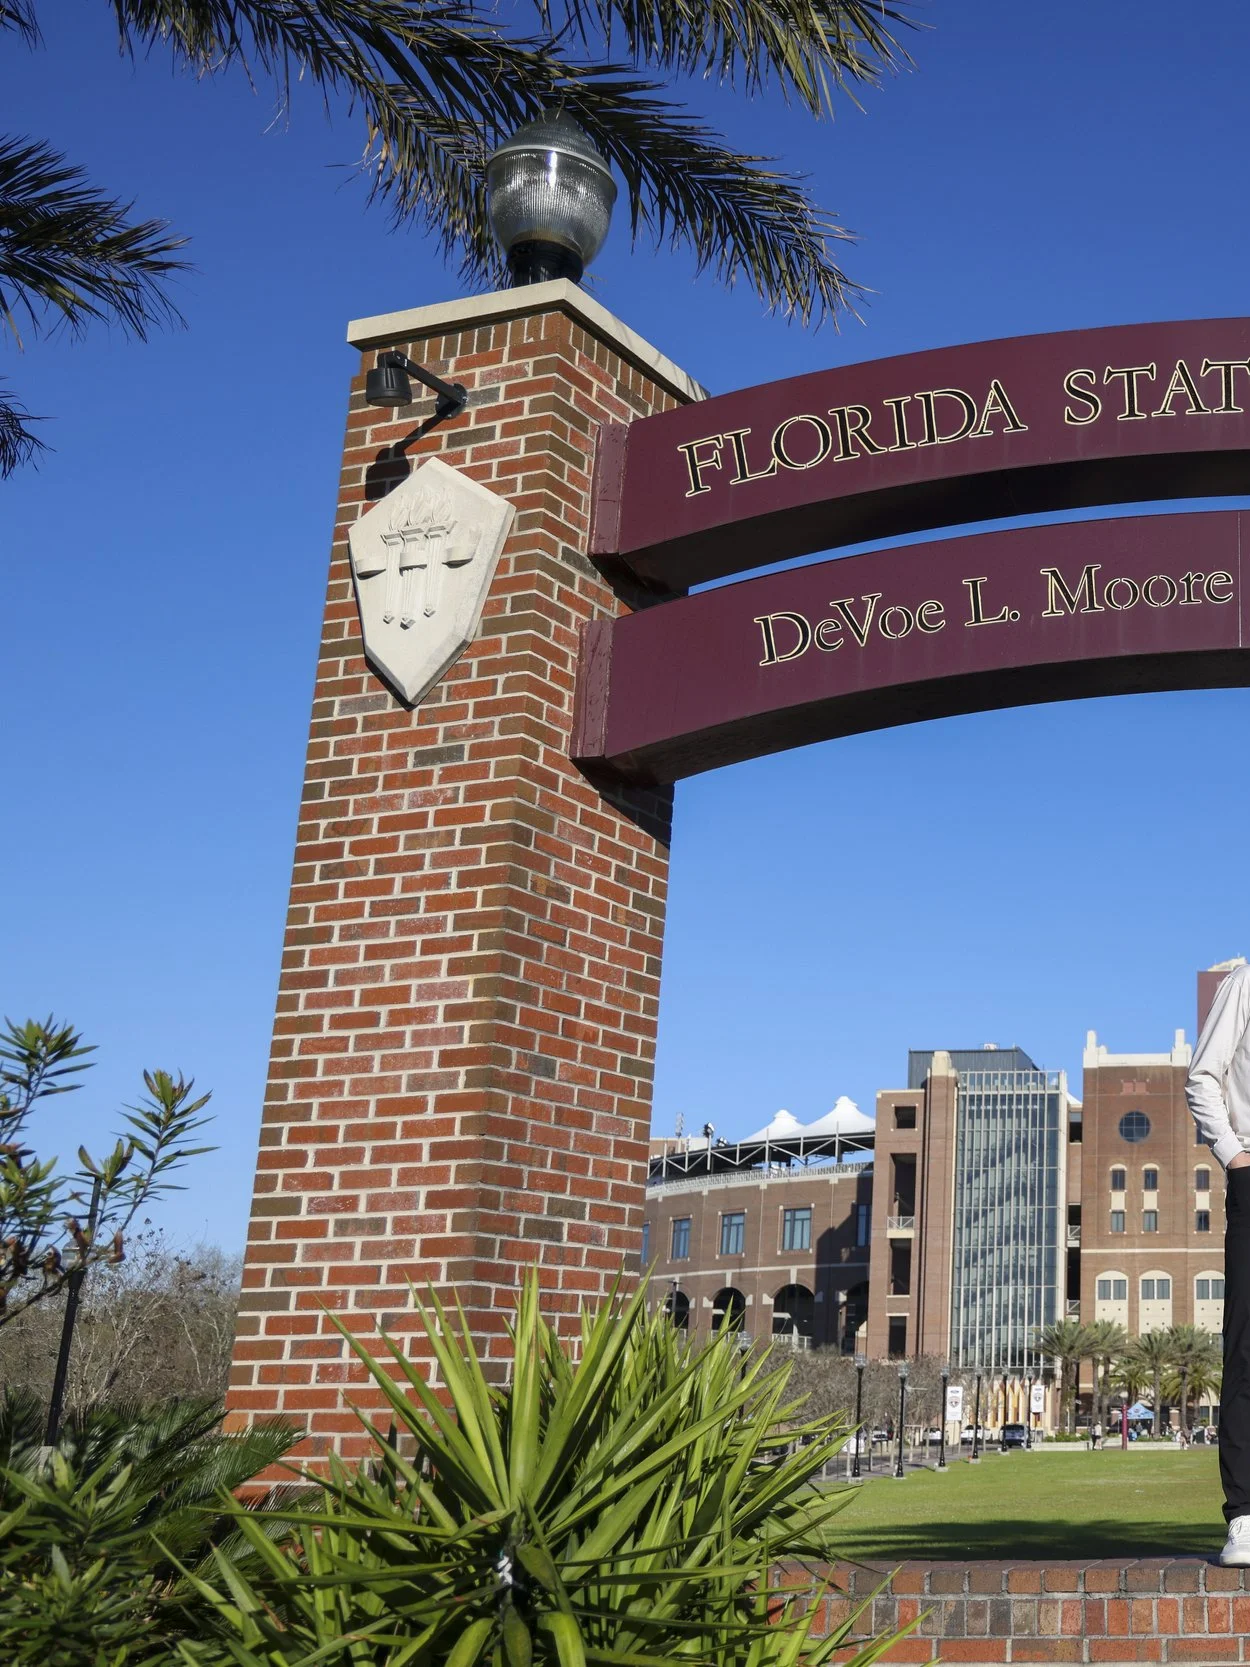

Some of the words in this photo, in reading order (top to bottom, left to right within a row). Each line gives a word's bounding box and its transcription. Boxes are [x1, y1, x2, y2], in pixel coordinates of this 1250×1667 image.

[677, 379, 1029, 498] FLORIDA
[753, 591, 946, 667] DeVoe
[962, 576, 1021, 628] L.
[1040, 563, 1234, 617] Moore
